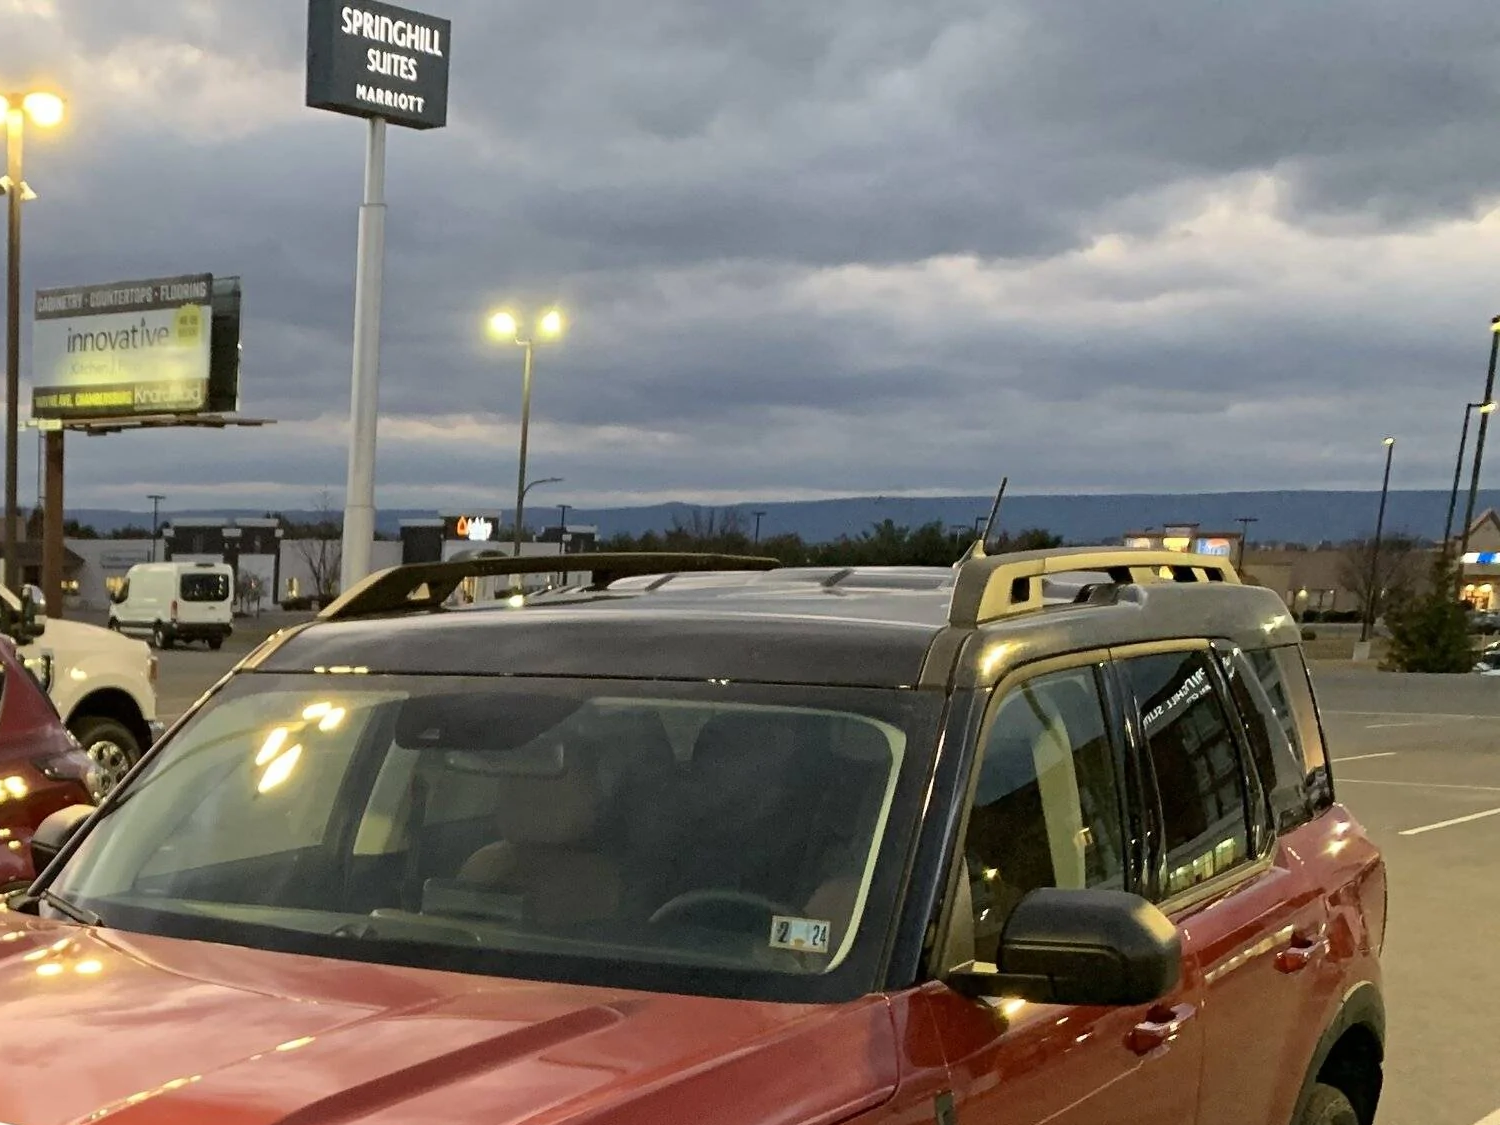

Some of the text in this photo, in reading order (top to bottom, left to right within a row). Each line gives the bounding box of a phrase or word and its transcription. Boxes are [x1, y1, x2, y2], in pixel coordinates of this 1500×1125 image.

[341, 6, 443, 57] SPRINGHILL
[366, 48, 418, 82] SUITES
[355, 83, 425, 113] MARRIOTT
[90, 287, 153, 308] COUNTERTOPS
[160, 282, 207, 301] FLOORING
[66, 317, 170, 352] innovative
[778, 921, 827, 947] 2 24
